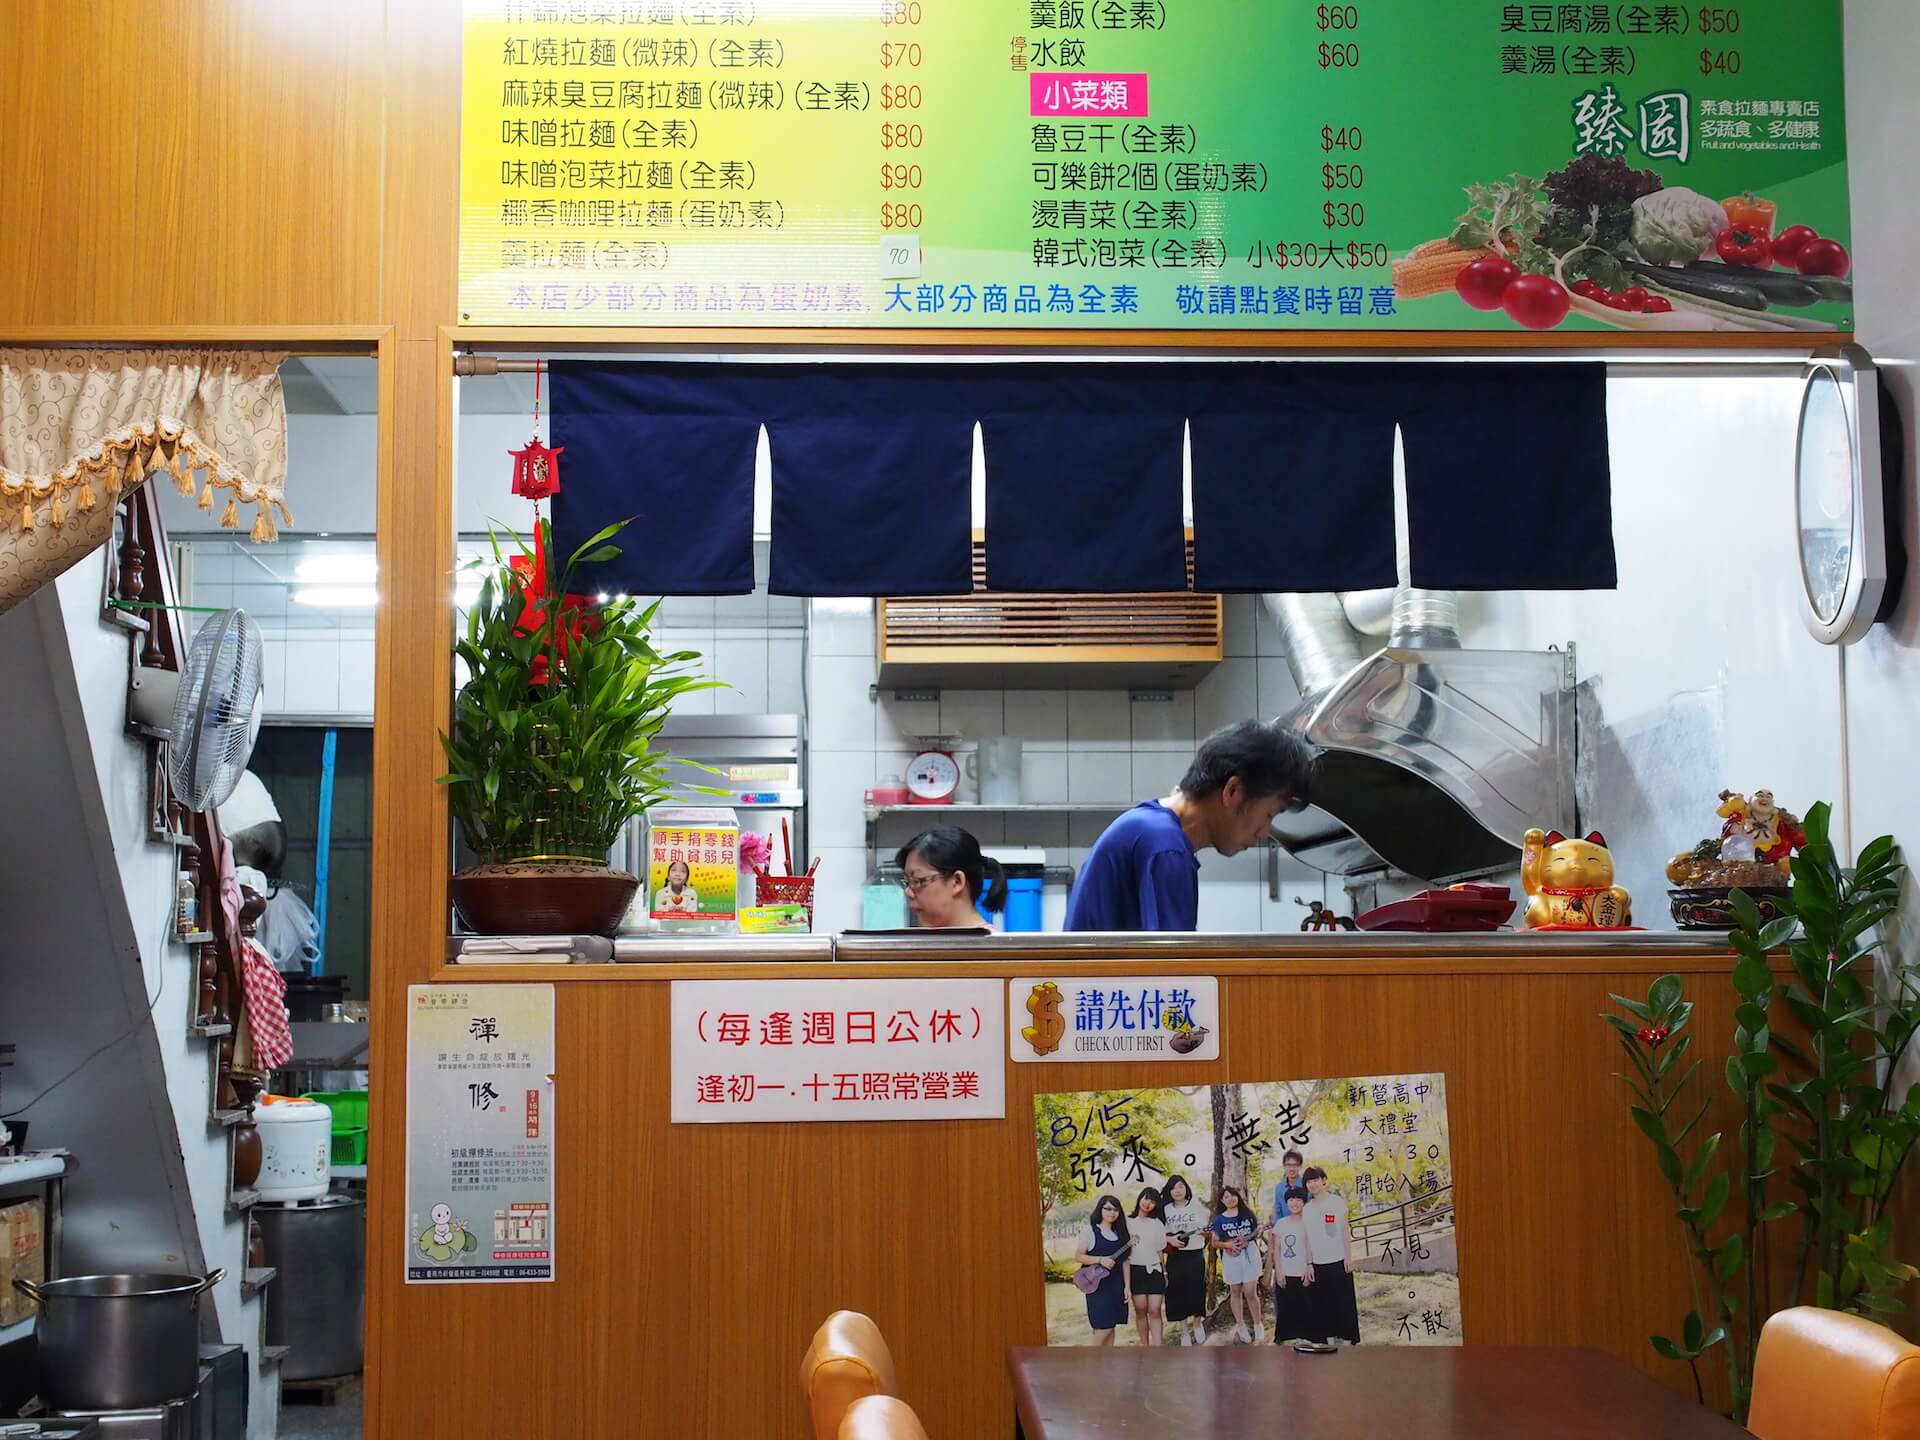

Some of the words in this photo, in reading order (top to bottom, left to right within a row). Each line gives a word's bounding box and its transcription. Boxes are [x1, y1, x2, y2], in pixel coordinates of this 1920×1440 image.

[880, 0, 922, 26] $80
[1030, 0, 1167, 31] 羹飯(全素)
[1316, 5, 1358, 31] $60
[1500, 4, 1689, 35] 臭豆腐湯(全素)
[1698, 8, 1740, 34] $50
[880, 41, 922, 69] $70
[1009, 35, 1028, 72] 停售
[1030, 37, 1086, 68] 水餃
[1317, 41, 1360, 69] $60
[1500, 45, 1636, 76] 羹湯(全素)
[1699, 48, 1741, 76] $40
[880, 83, 922, 111] $80
[1043, 80, 1129, 111] 小菜類
[1700, 100, 1820, 117] 素食拉麵專賣店
[502, 118, 699, 150] 味噌拉麵(全素)
[880, 123, 923, 151] $80
[1031, 124, 1198, 155] 魯豆干(全素)
[1320, 125, 1363, 153] $40
[502, 159, 755, 191] 味噌泡菜拉麵(全素)
[880, 163, 923, 190] $90
[1032, 161, 1269, 193] 可樂餅2個(蛋奶素)
[1321, 165, 1364, 193] $50
[501, 199, 784, 231] 椰香咖哩拉麵(蛋奶素)
[880, 203, 923, 230] $80
[1032, 199, 1198, 230] 燙青菜(全素)
[1322, 202, 1364, 230] $30
[888, 248, 909, 265] 70
[1032, 238, 1227, 269] 韓式泡菜(全素)
[1246, 240, 1389, 270] 小$30大$50
[884, 284, 1139, 315] 大部分商品為全素
[1176, 284, 1397, 316] 敬請點餐時留意
[653, 831, 735, 848] 順手捐零錢
[1074, 988, 1197, 1032] 請先付款
[469, 1017, 499, 1044] 禪
[1075, 1035, 1111, 1052] CHECK
[1112, 1035, 1133, 1051] OUT
[1135, 1035, 1165, 1051] FIRST
[468, 1082, 499, 1112] 修
[1346, 1083, 1431, 1107] 新營高中
[1050, 1096, 1131, 1148] 8/15
[1359, 1113, 1419, 1137] 大禮堂
[1355, 1171, 1439, 1196] 開始入場
